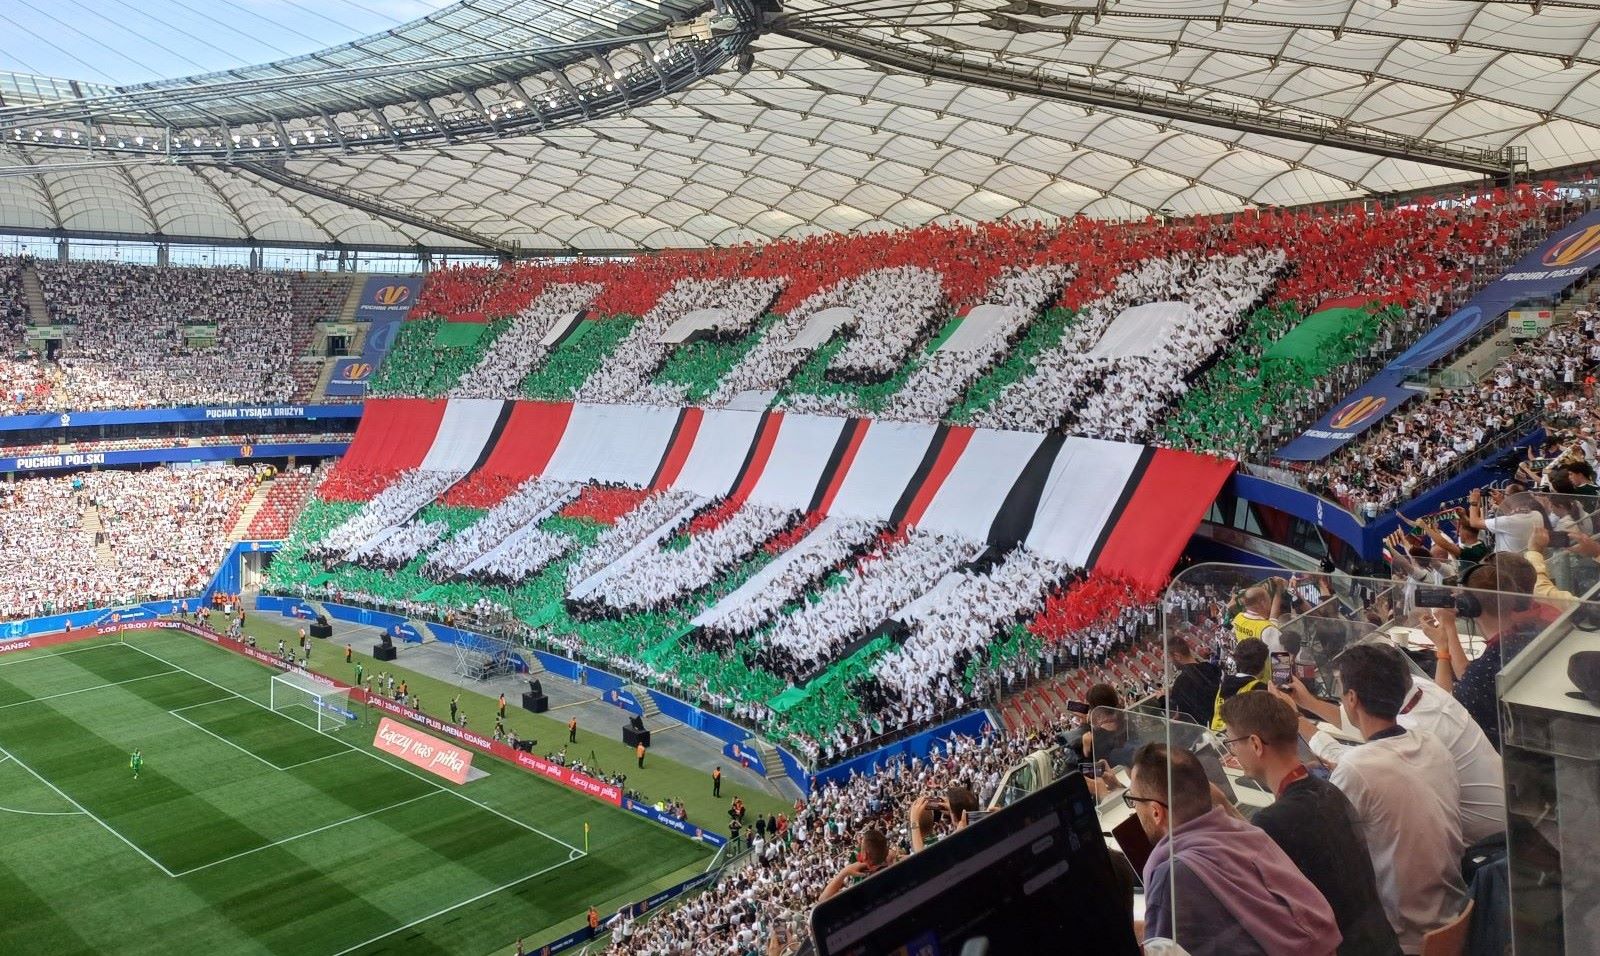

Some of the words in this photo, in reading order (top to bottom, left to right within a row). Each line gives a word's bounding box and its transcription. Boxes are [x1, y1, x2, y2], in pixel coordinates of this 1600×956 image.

[1500, 272, 1548, 281] PUCHAR
[206, 409, 238, 418] PUCHAR
[240, 408, 272, 418] TYSIĄCA
[274, 406, 304, 416] DRUŻYN
[16, 456, 63, 469] PUCHAR
[65, 454, 105, 465] POLSKI
[97, 625, 117, 635] 3.06
[153, 620, 181, 628] POLSAT
[0, 640, 31, 652] DAŃSK
[403, 709, 427, 724] POLSAT
[425, 718, 442, 730] PLUS
[441, 725, 463, 738] ARENA
[463, 733, 492, 749] GDAŃSK
[379, 724, 412, 753] Łączy
[411, 741, 434, 757] nas
[430, 753, 465, 774] piłka
